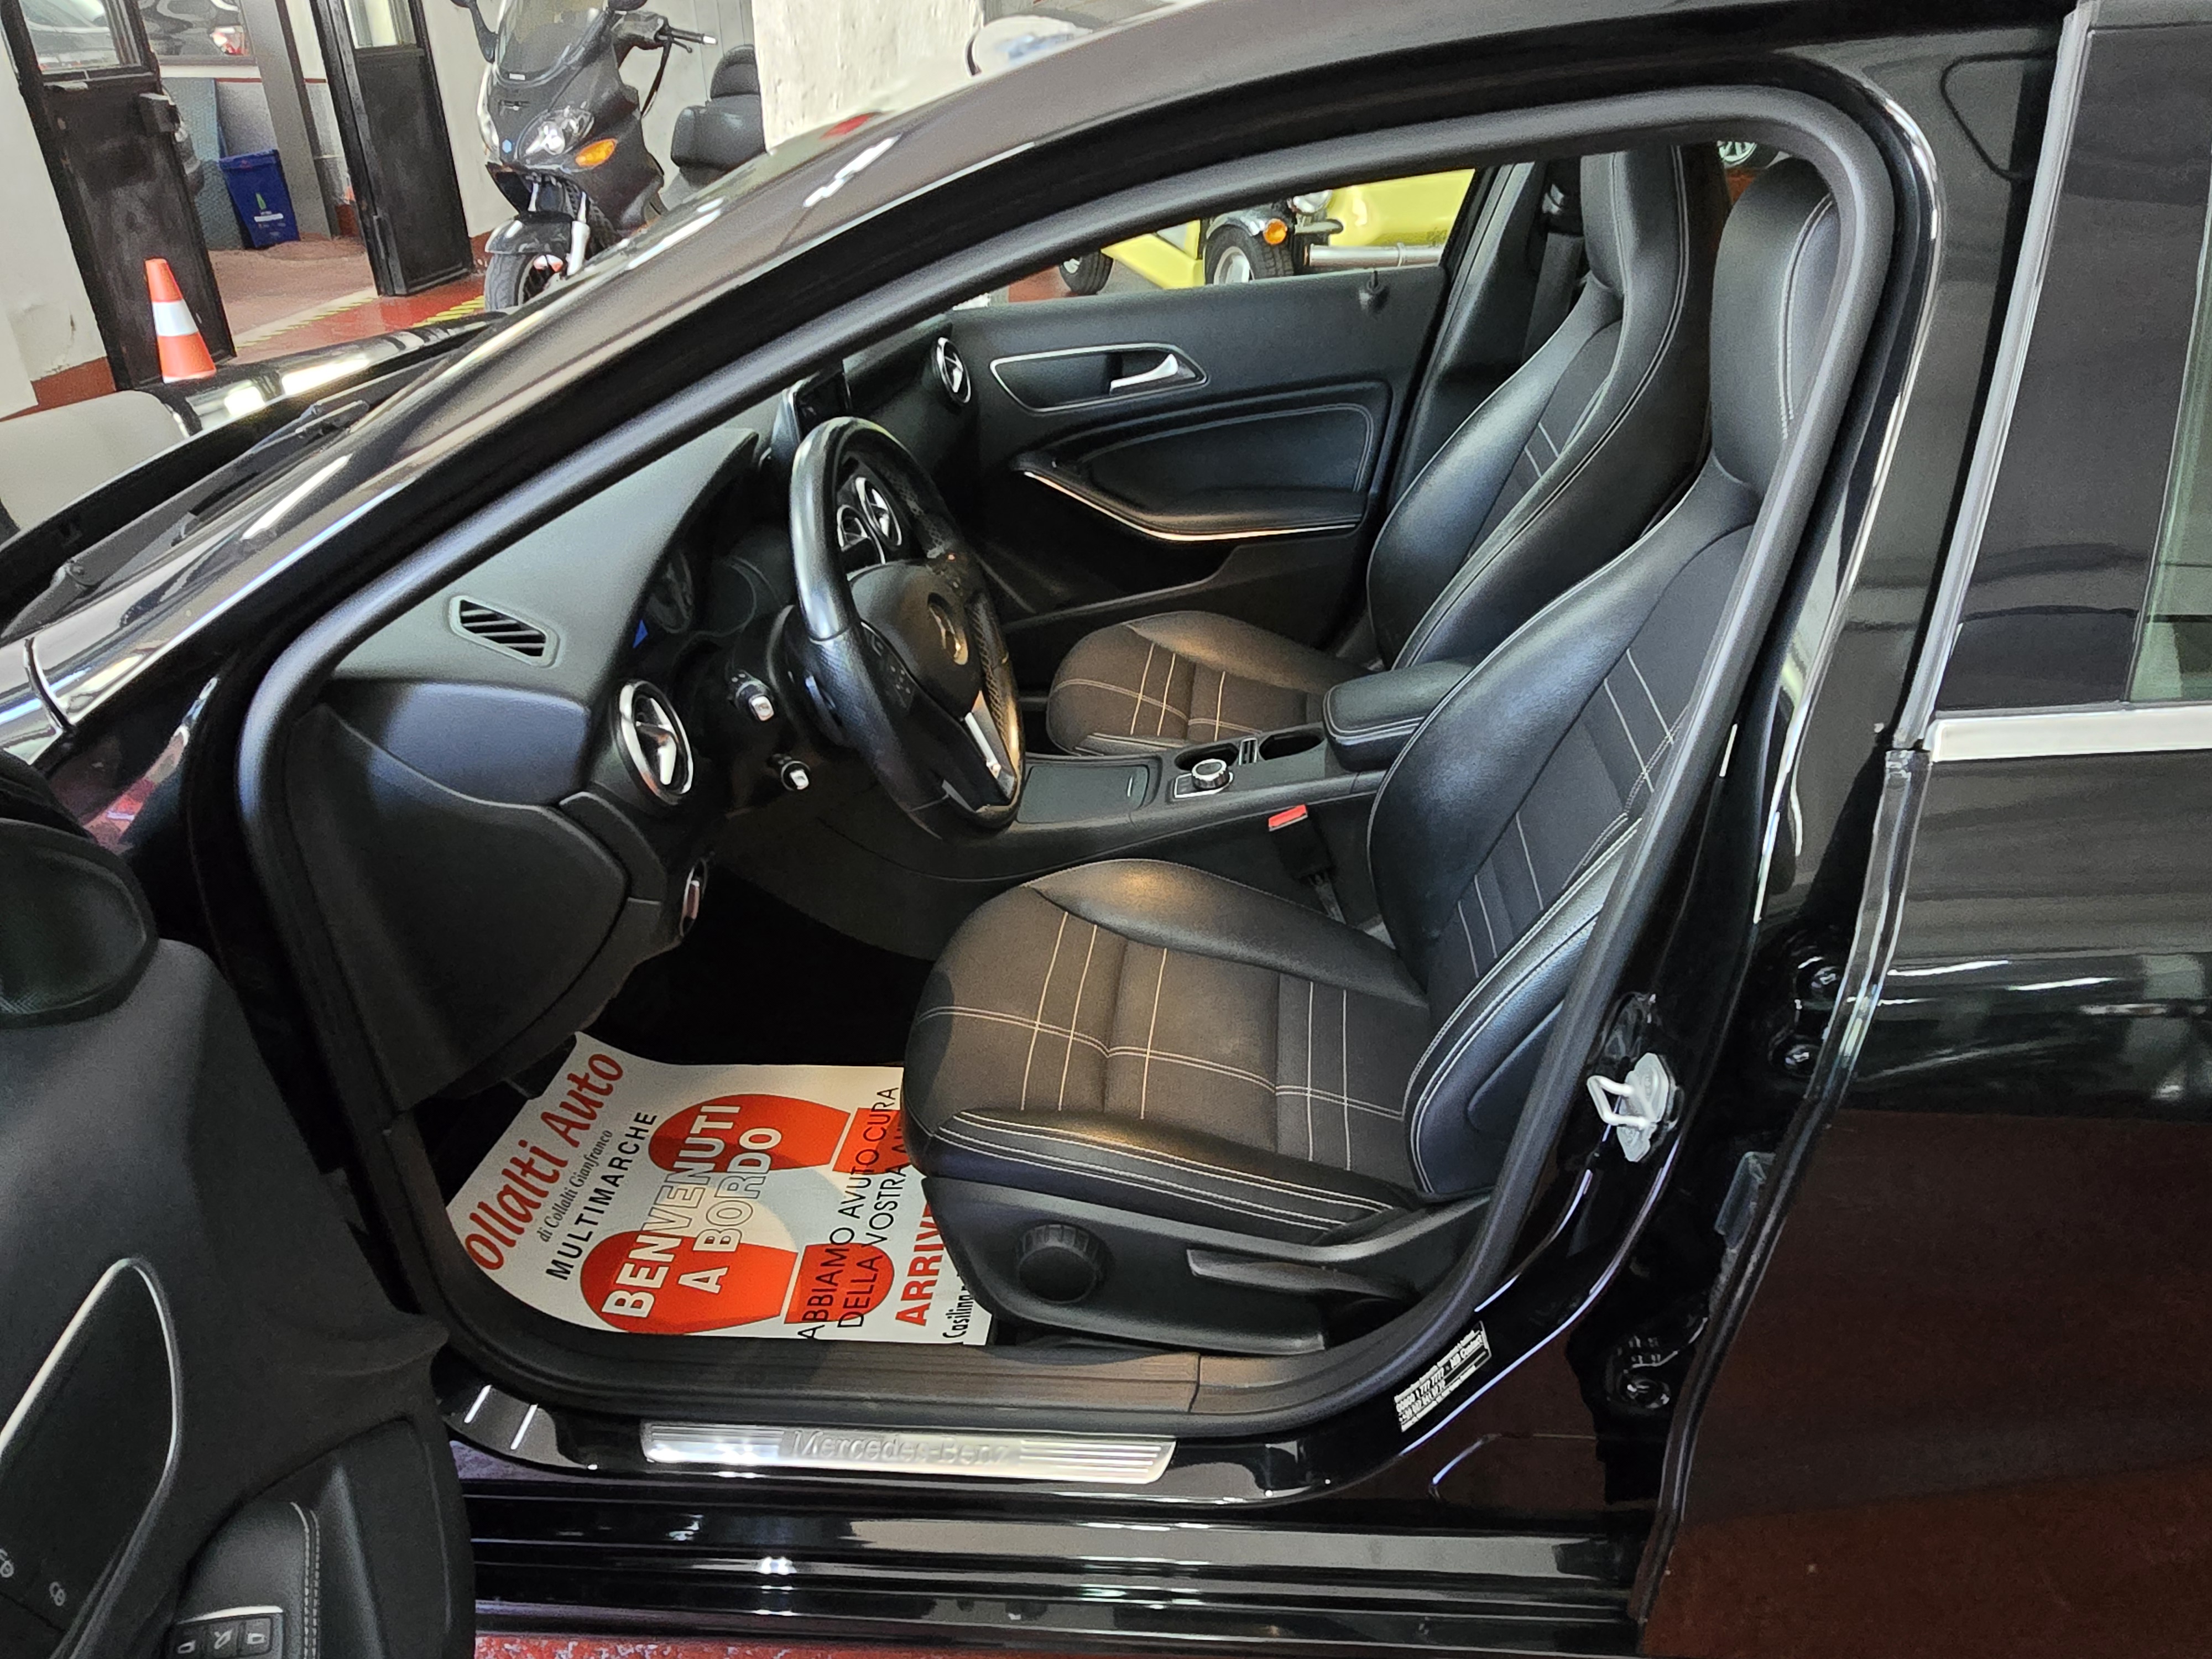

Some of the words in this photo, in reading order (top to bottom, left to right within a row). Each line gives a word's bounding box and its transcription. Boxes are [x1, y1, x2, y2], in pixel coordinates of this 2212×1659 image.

[540, 1054, 623, 1148] Auto
[544, 1187, 578, 1229] Collalti
[546, 1112, 657, 1280] MULTIMARCHE
[569, 1130, 612, 1188] Gianfranco
[601, 1105, 741, 1318] BENVENUTI
[692, 1127, 782, 1252] BORDO
[797, 1227, 855, 1339] ABBIAMO
[837, 1149, 879, 1219] AVUTO
[863, 1087, 899, 1142] CURA
[536, 1227, 553, 1243] di
[677, 1265, 730, 1294] A
[837, 1255, 883, 1328] DELLA
[860, 1162, 910, 1248] VOSTRA
[895, 1201, 945, 1327] ARRIV
[791, 1429, 1011, 1465] Mercedes-Benz
